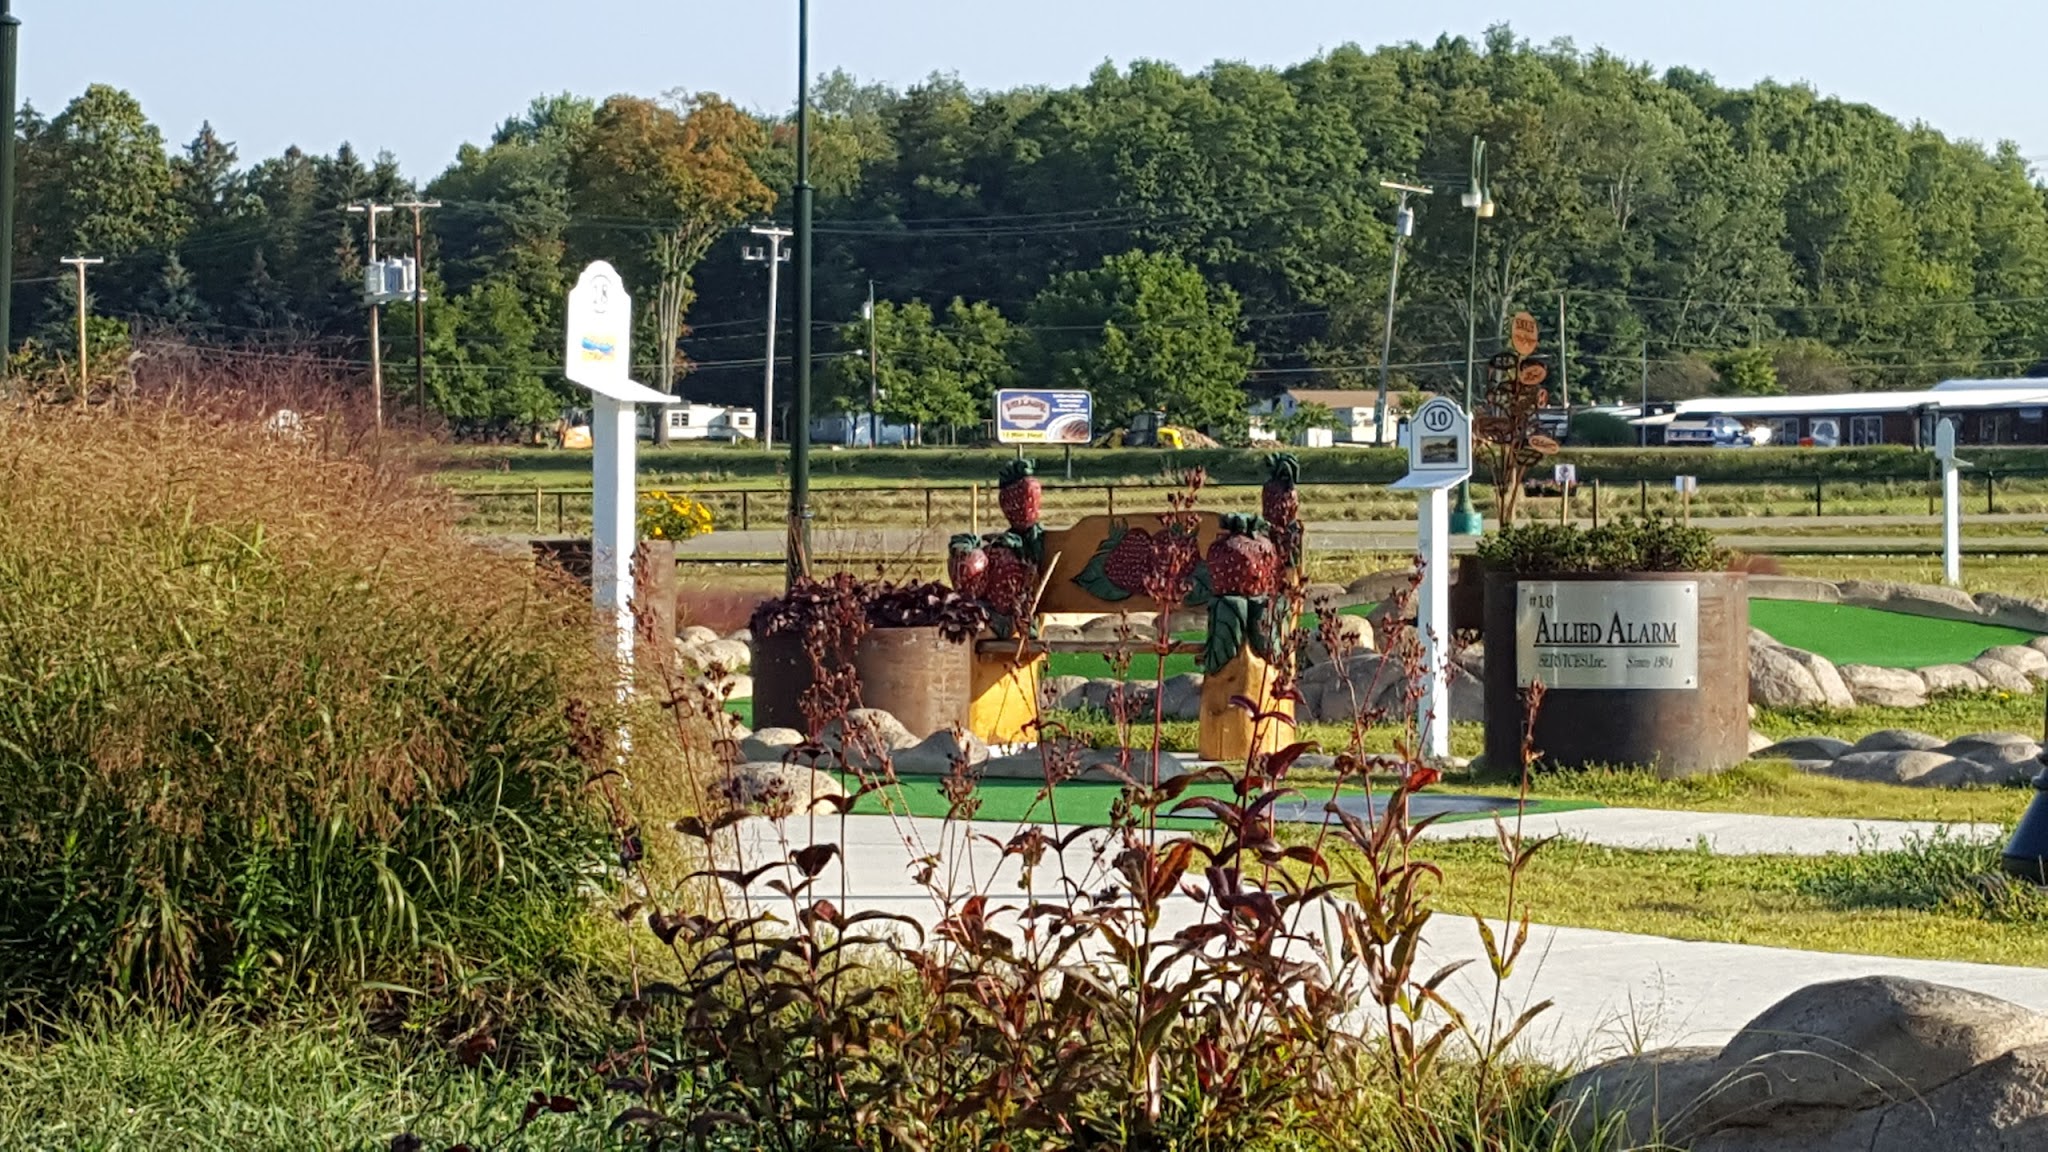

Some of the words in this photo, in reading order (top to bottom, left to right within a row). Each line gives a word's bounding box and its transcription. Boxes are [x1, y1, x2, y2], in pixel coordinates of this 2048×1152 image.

[1429, 410, 1448, 426] 10
[1535, 610, 1603, 644] ALLIED
[1606, 610, 1678, 644] ALARM
